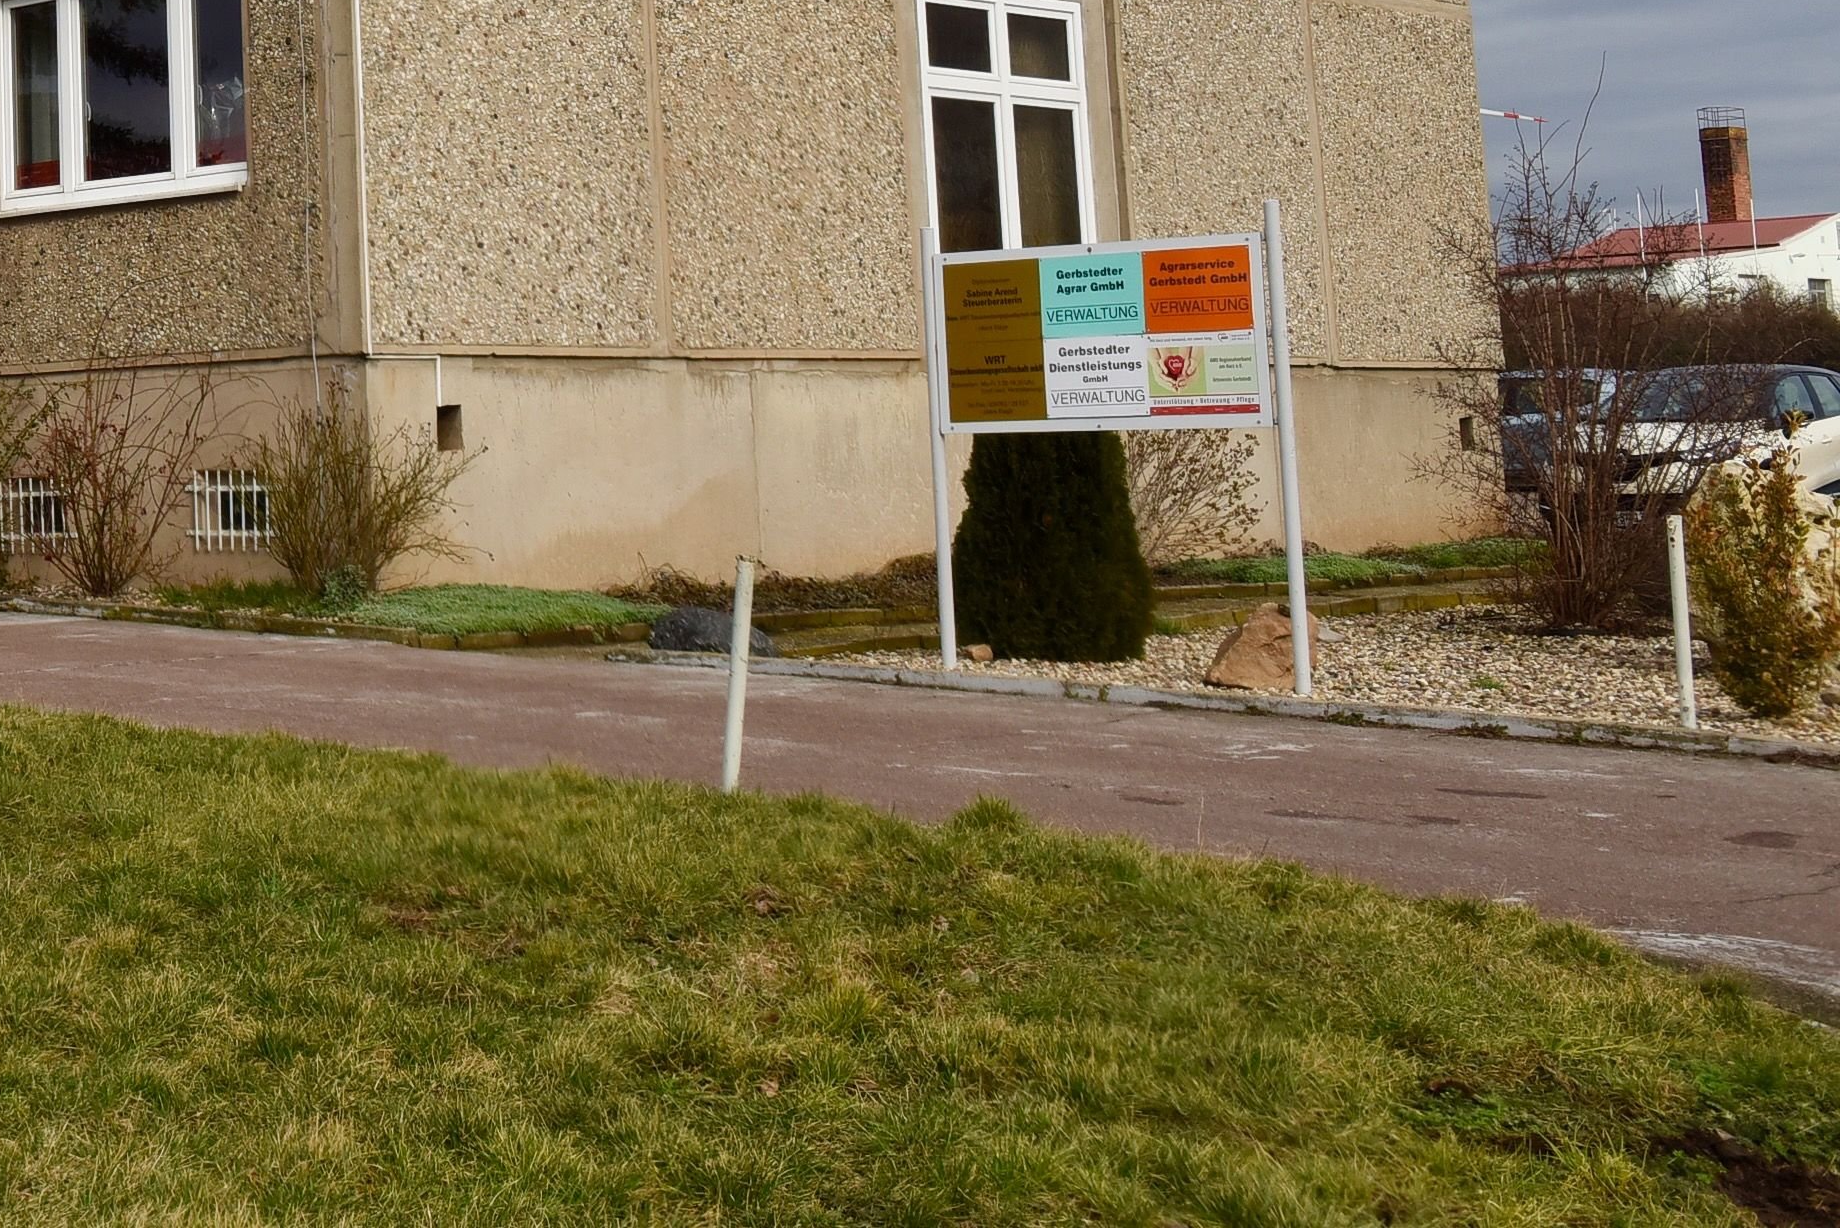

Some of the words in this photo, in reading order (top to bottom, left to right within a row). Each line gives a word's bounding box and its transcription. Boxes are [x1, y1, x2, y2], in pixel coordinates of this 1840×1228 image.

[1160, 259, 1235, 273] Agrarservice
[1056, 267, 1123, 280] Gerbstedter
[1149, 275, 1206, 286] Gerbstedt
[1210, 273, 1247, 284] GmbH
[1056, 284, 1087, 295] Agrar
[1090, 280, 1124, 292] GmbH
[962, 297, 1023, 307] Steuerberaterin
[1150, 297, 1249, 314] VERWALTUNG
[1046, 305, 1138, 322] VERWALTUNG
[1058, 344, 1130, 357] Gerbstedter
[984, 355, 1006, 365] WRT
[1049, 360, 1143, 373] Dienstleistungs
[1082, 375, 1108, 383] GmbH
[1051, 389, 1145, 405] VERWALTUNG
